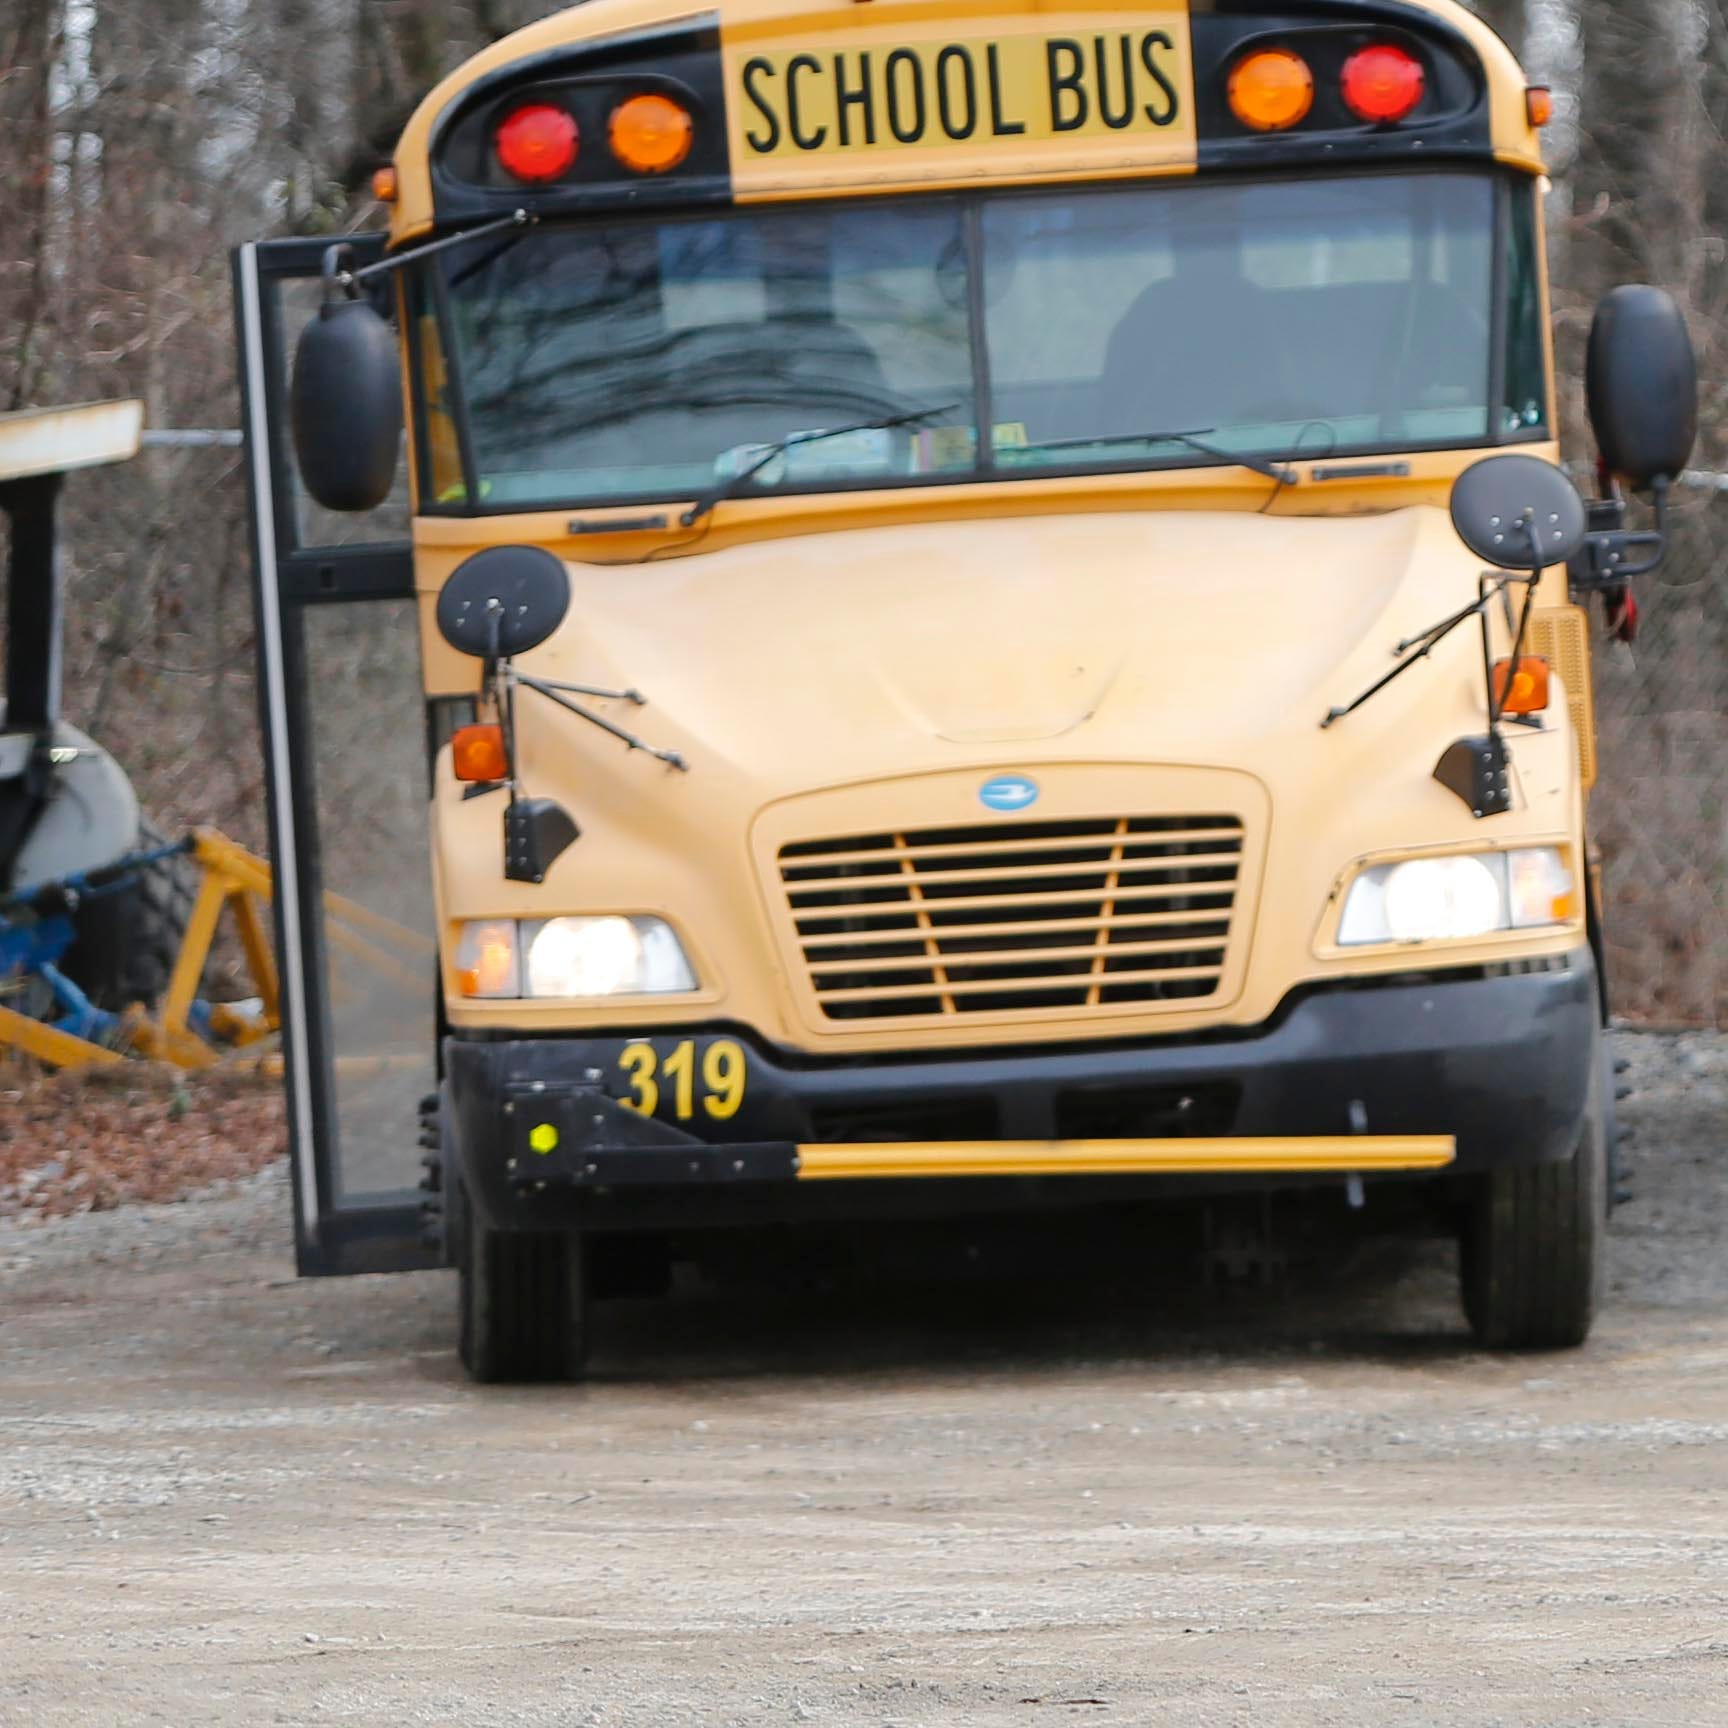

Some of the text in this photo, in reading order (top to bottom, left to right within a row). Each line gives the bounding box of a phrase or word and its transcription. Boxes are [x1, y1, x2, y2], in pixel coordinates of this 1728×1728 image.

[742, 30, 1179, 153] SCHOOL BUS
[616, 1040, 746, 1120] 319
